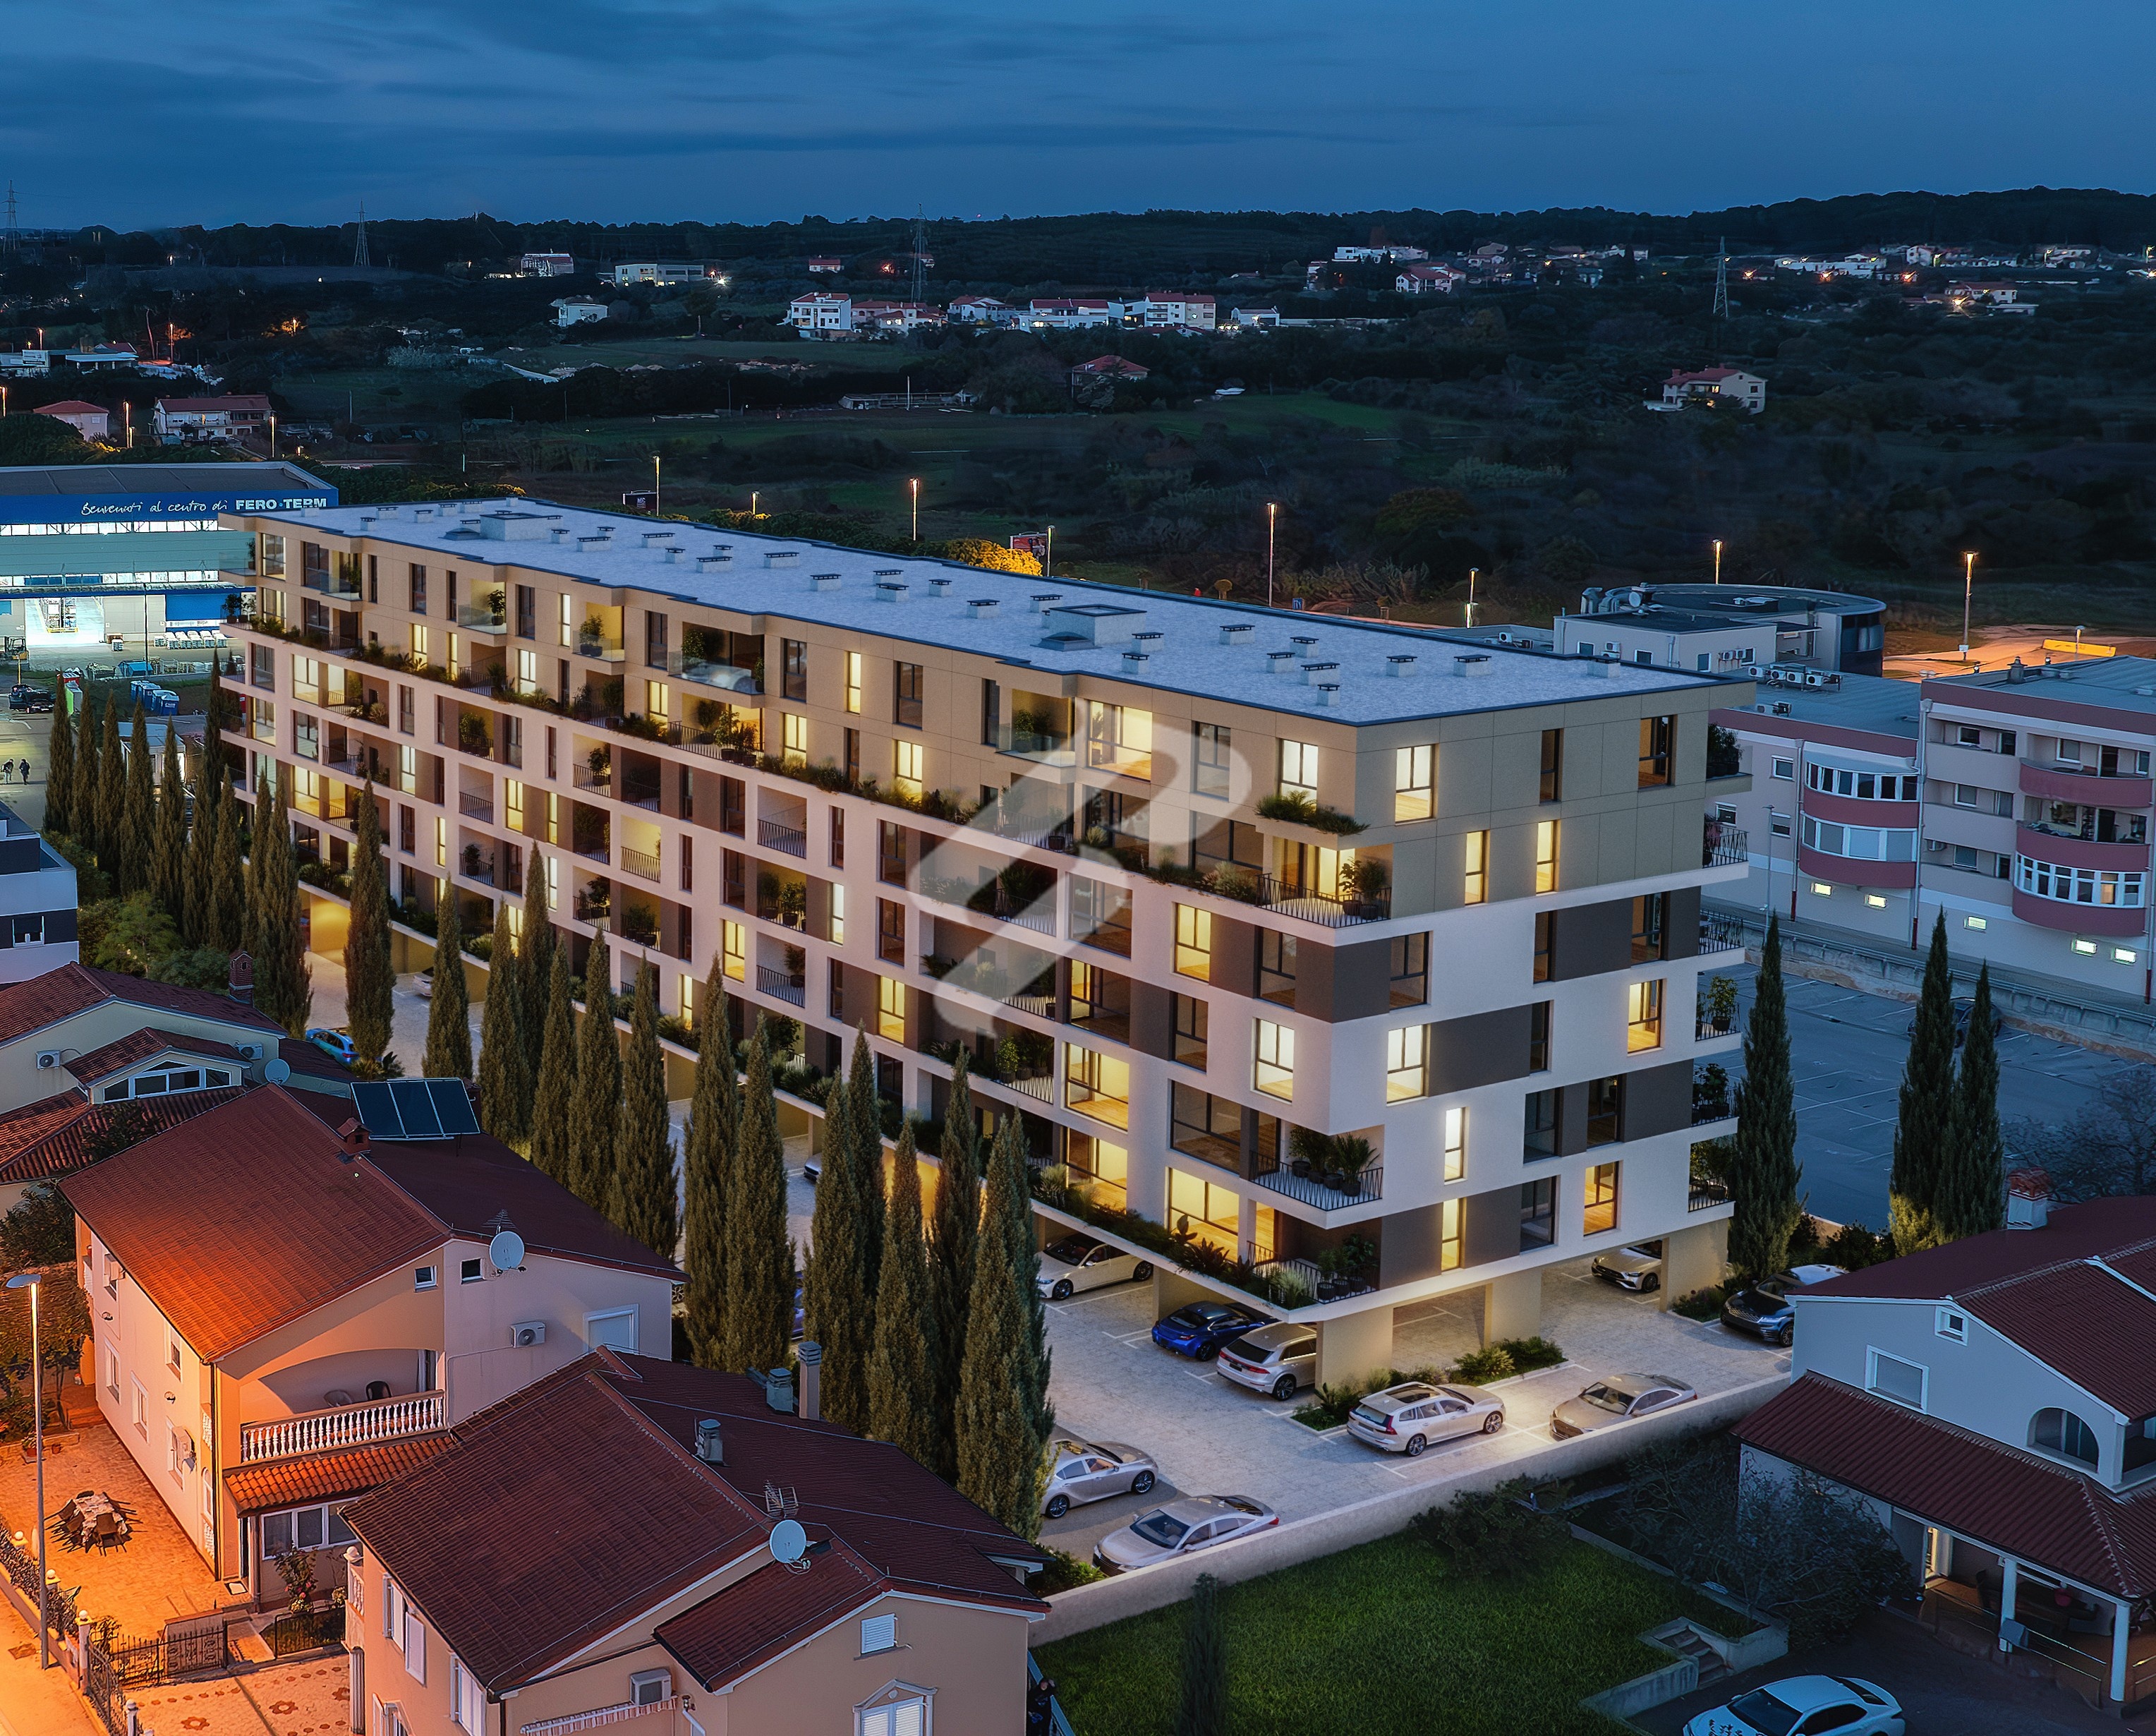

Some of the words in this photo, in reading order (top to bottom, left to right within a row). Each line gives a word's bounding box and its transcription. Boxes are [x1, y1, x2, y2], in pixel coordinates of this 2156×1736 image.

[150, 500, 163, 512] al
[167, 500, 207, 513] centro
[212, 500, 228, 511] di
